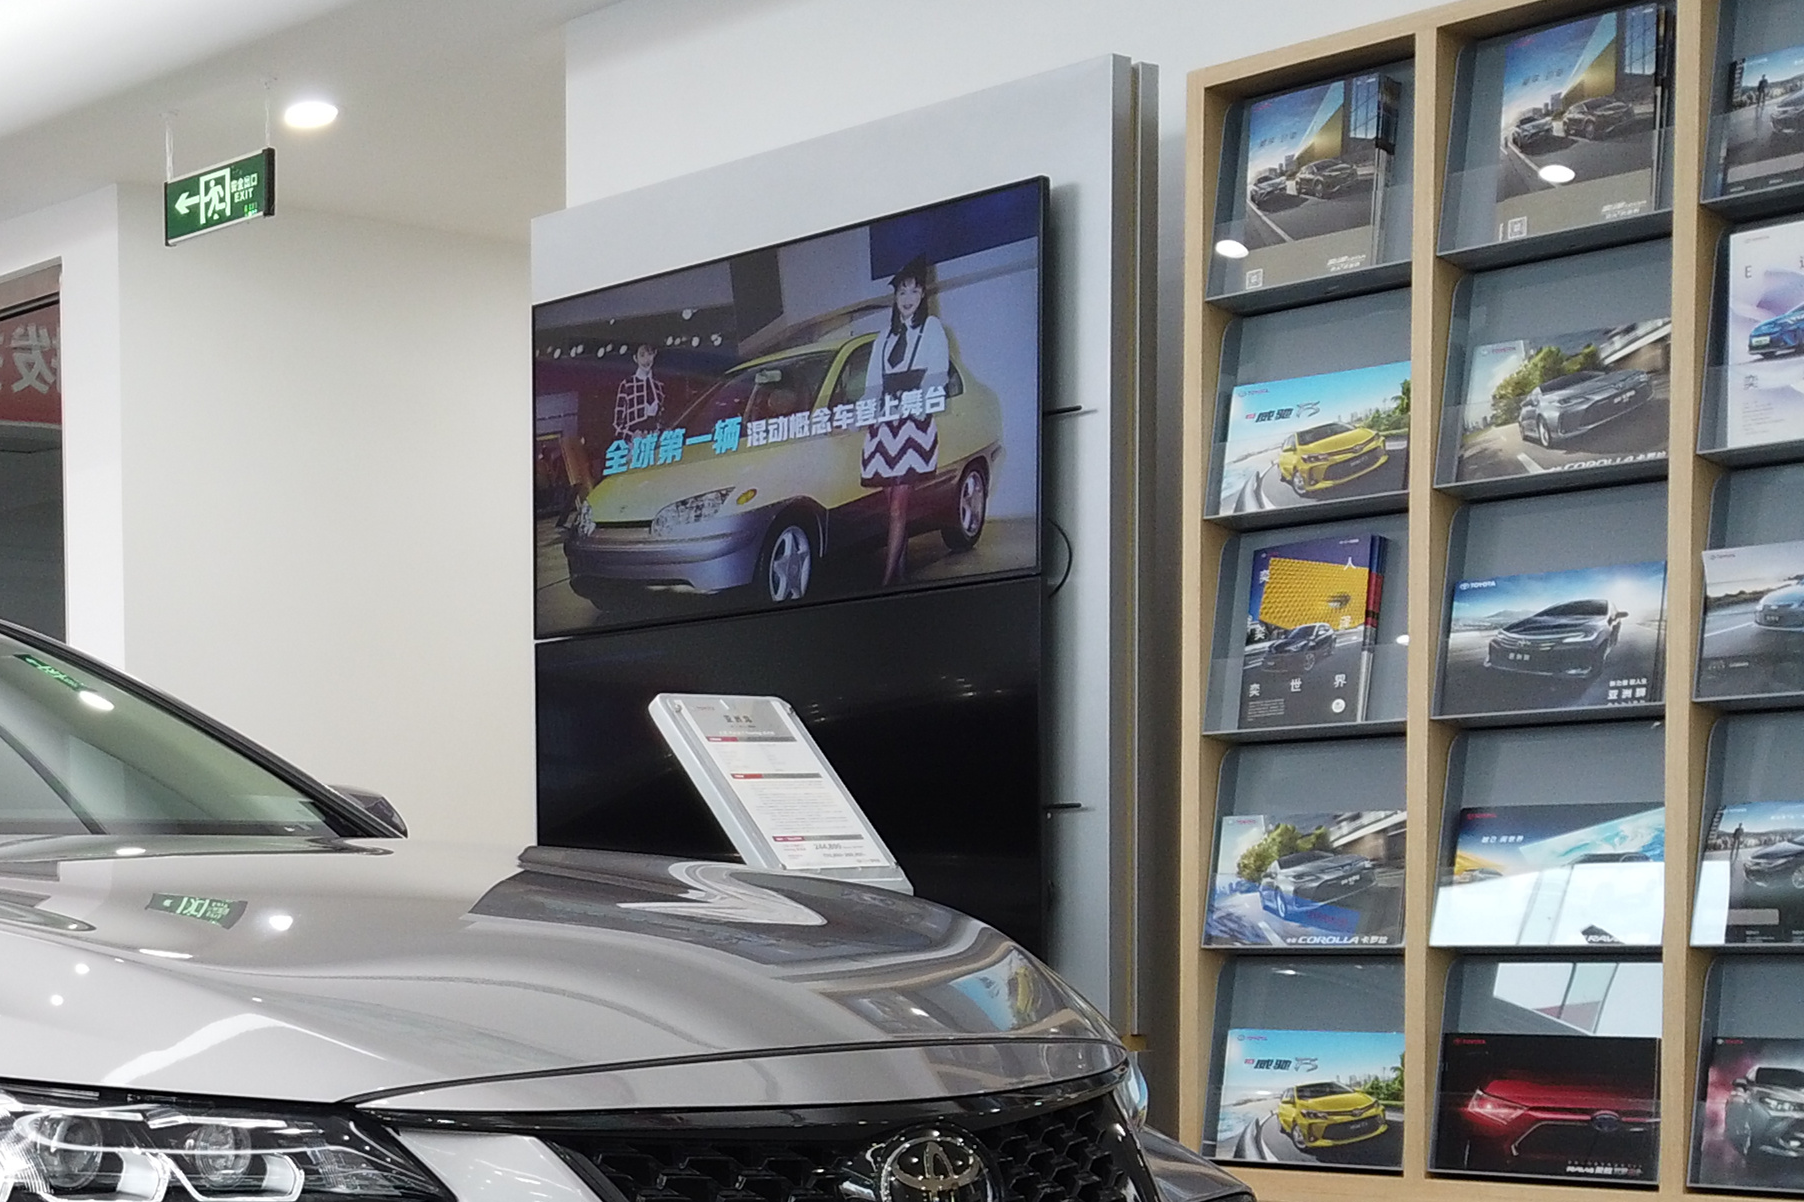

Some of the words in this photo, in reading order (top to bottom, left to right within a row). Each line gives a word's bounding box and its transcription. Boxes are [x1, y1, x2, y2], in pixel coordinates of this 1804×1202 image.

[234, 188, 254, 203] EXIT
[1470, 580, 1496, 589] TOYOTA
[1298, 936, 1359, 945] COROLLA
